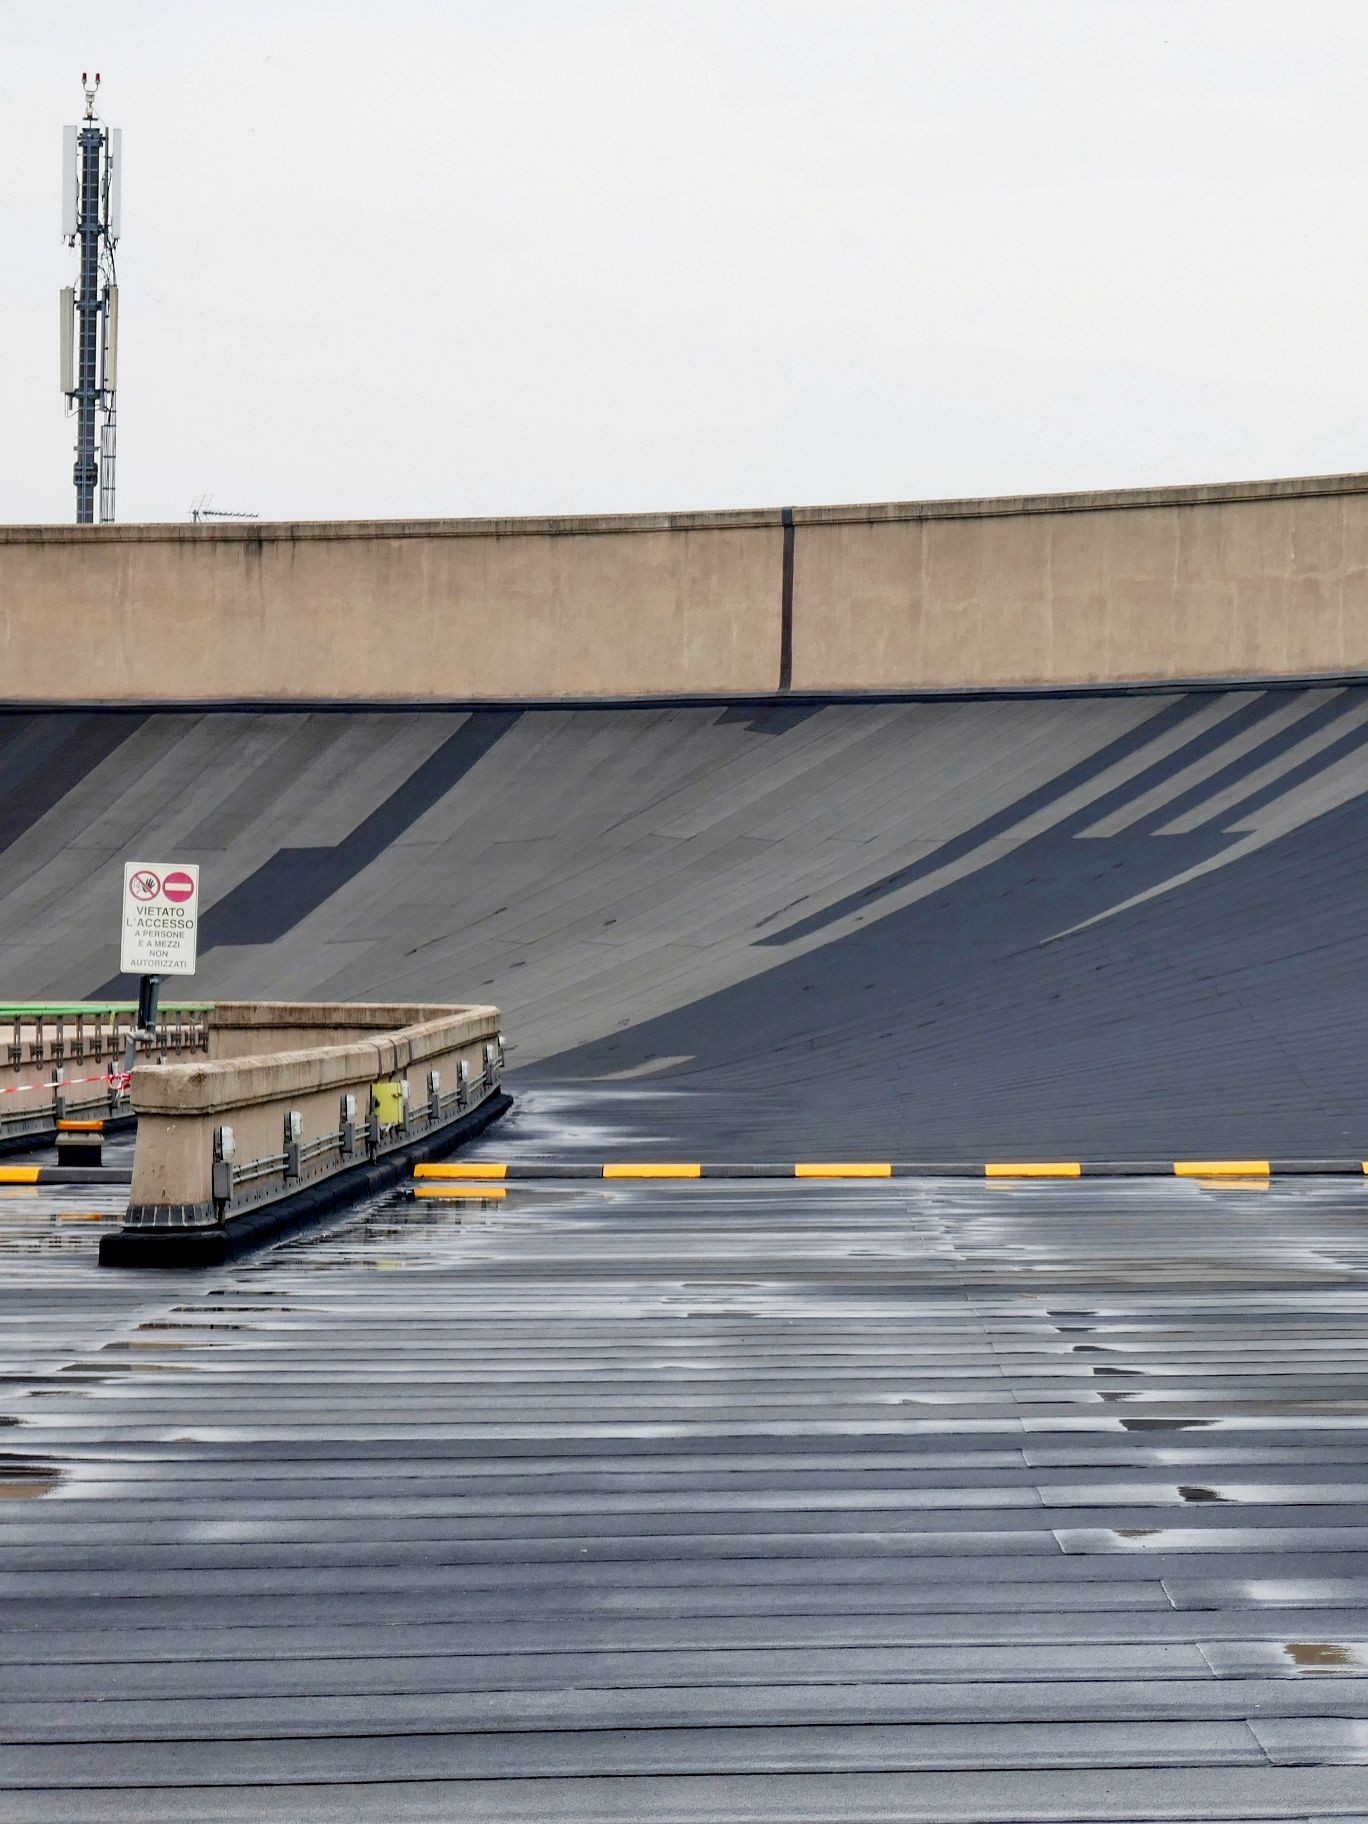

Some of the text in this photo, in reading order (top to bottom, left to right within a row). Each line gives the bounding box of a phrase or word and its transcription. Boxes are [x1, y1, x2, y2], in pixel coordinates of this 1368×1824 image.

[137, 906, 185, 917] VIETATO
[126, 918, 194, 929] L'ACCESSO
[143, 930, 185, 939] PERSONE
[154, 941, 180, 949] MEZZI
[130, 959, 187, 968] AUTORIZZATI
